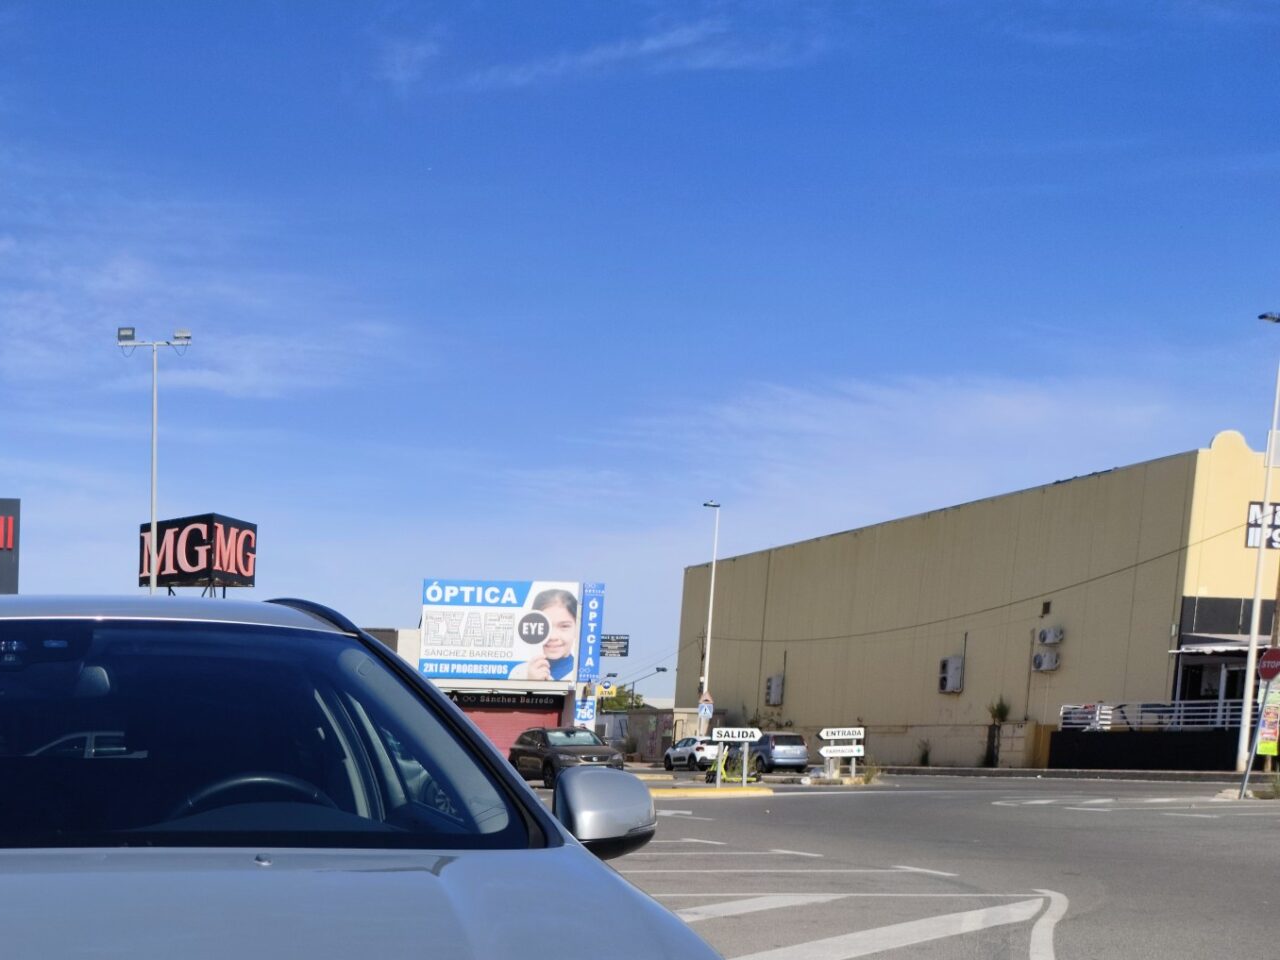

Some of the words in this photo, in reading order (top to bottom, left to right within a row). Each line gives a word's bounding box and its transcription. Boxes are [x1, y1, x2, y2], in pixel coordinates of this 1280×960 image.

[140, 523, 211, 577] MG
[213, 522, 256, 577] MG
[425, 581, 518, 604] ÓPTICA
[522, 621, 545, 636] EYE
[423, 661, 438, 673] 2X1
[439, 662, 449, 673] EN
[451, 663, 509, 675] PROGRESIVOS
[716, 730, 755, 739] SALIDA
[825, 729, 862, 737] ENTRADA
